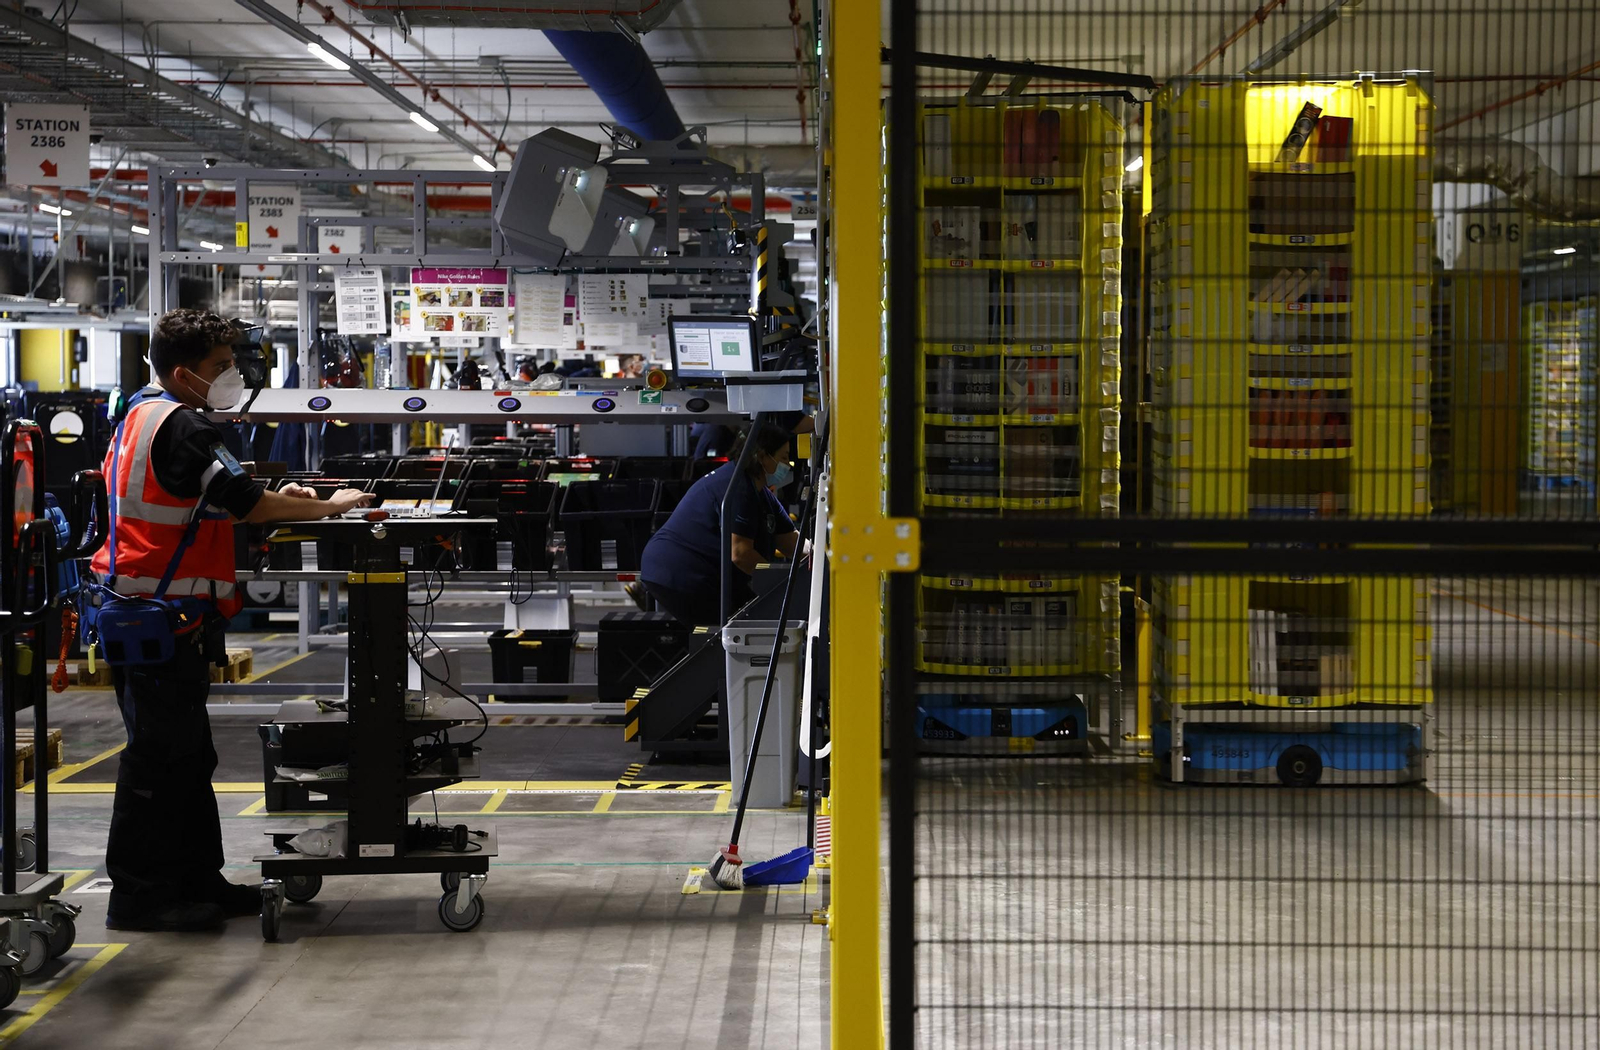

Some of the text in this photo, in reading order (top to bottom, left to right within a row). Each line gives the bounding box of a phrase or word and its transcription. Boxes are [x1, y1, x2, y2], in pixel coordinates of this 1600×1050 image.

[16, 119, 80, 132] STATION
[31, 135, 66, 148] 2386
[249, 197, 294, 206] STATION
[259, 208, 283, 217] 2383
[324, 228, 345, 238] 2382
[965, 373, 991, 384] YOUR
[965, 384, 991, 393] CHOICE
[965, 393, 991, 403] TIME
[923, 728, 955, 739] 453933
